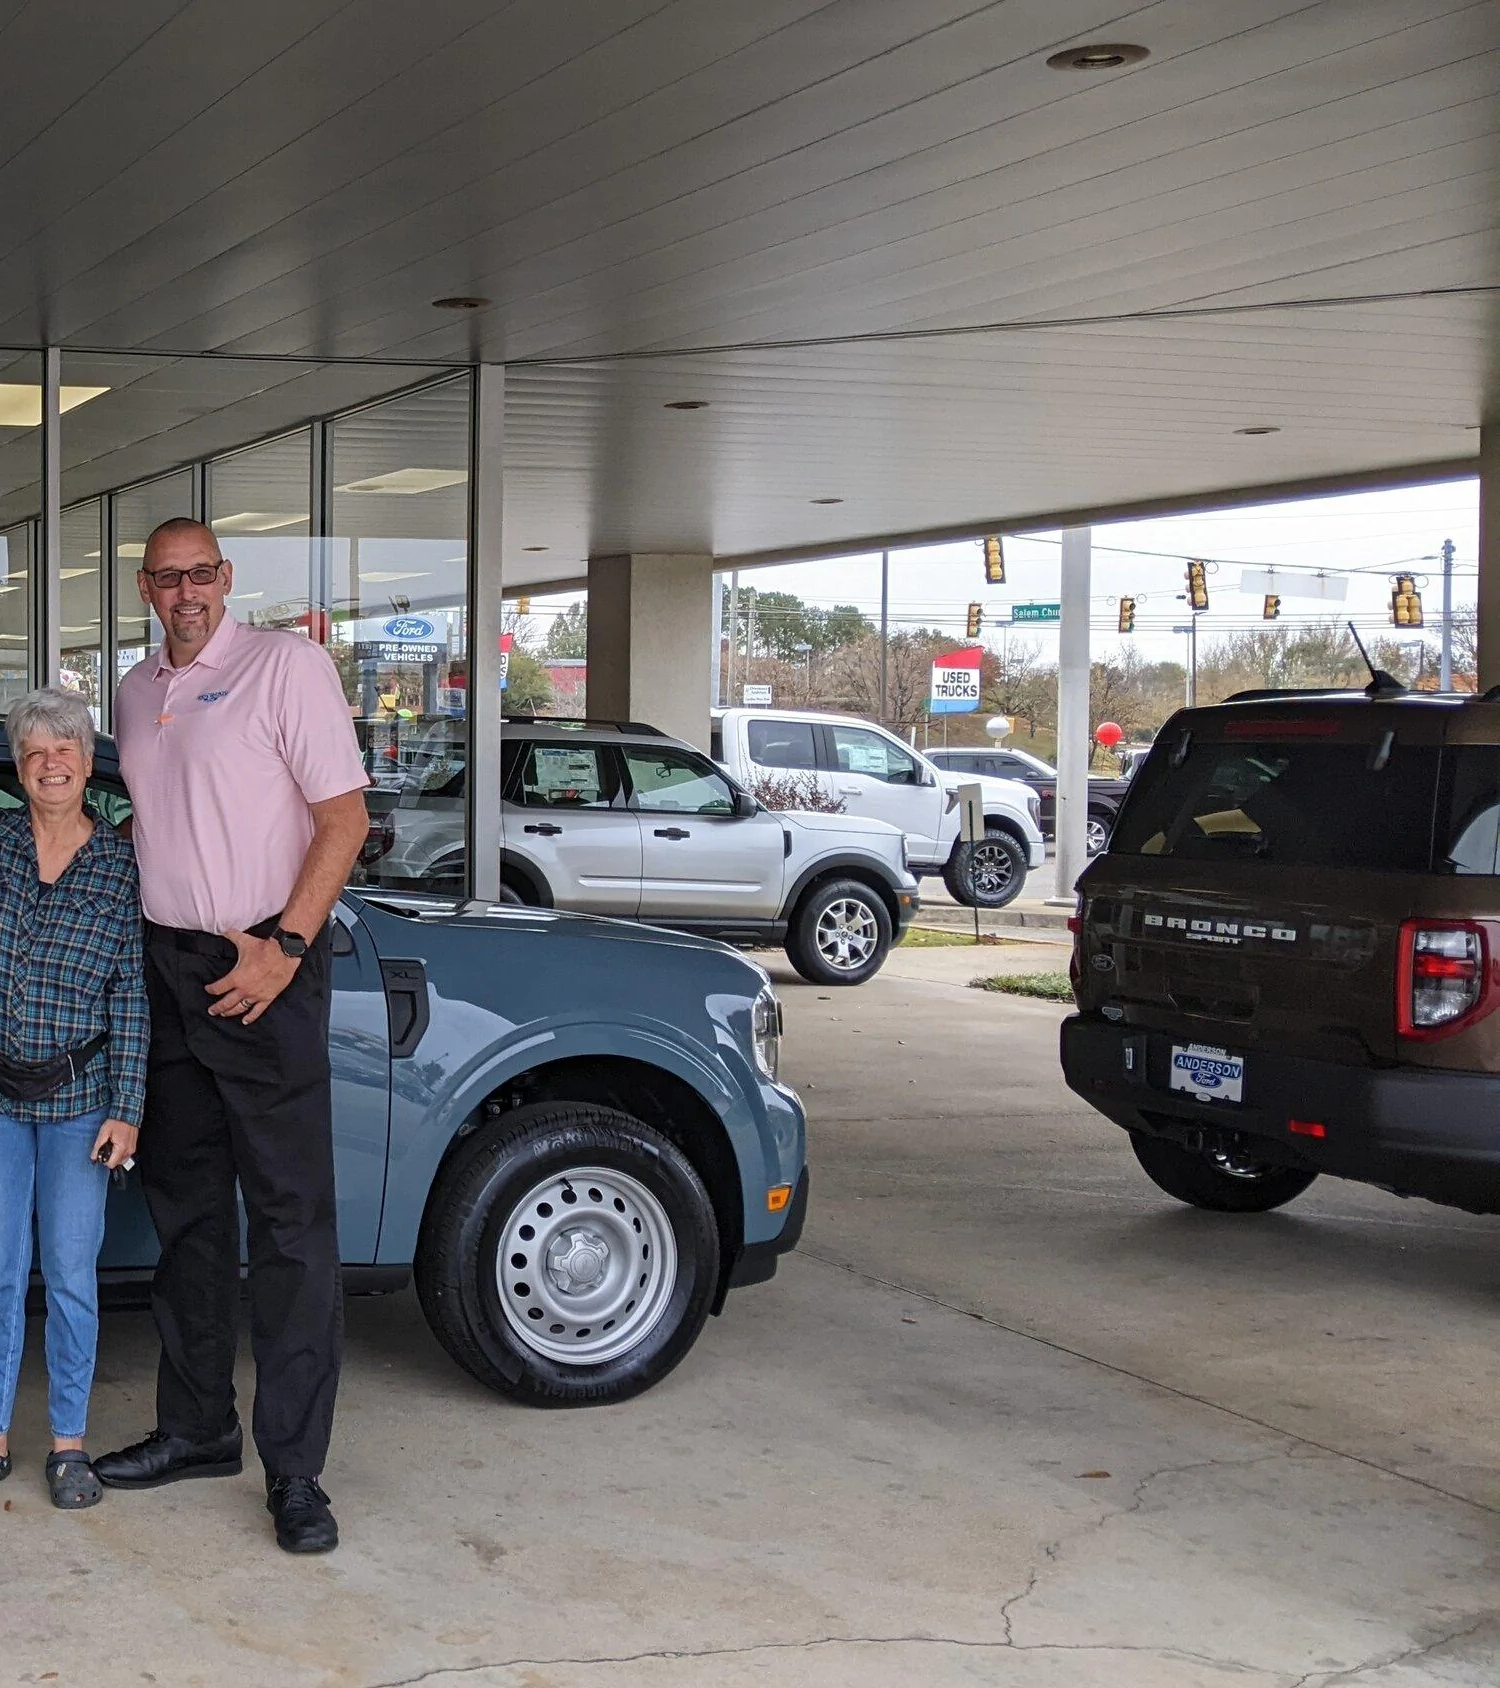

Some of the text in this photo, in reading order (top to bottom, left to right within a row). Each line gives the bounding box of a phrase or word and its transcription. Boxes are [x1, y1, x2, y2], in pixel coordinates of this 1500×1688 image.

[1013, 608, 1039, 618] Salem
[392, 620, 424, 637] Ford
[379, 643, 438, 653] PRE-OWNED
[383, 653, 434, 662] VEHICLES
[942, 671, 971, 684] USED
[935, 685, 978, 698] TRUCKS
[1144, 915, 1297, 941] BRONCO
[1185, 933, 1242, 944] SPORT
[389, 970, 419, 980] XL
[1175, 1056, 1241, 1078] ANDERSON
[1195, 1072, 1217, 1086] Ford
